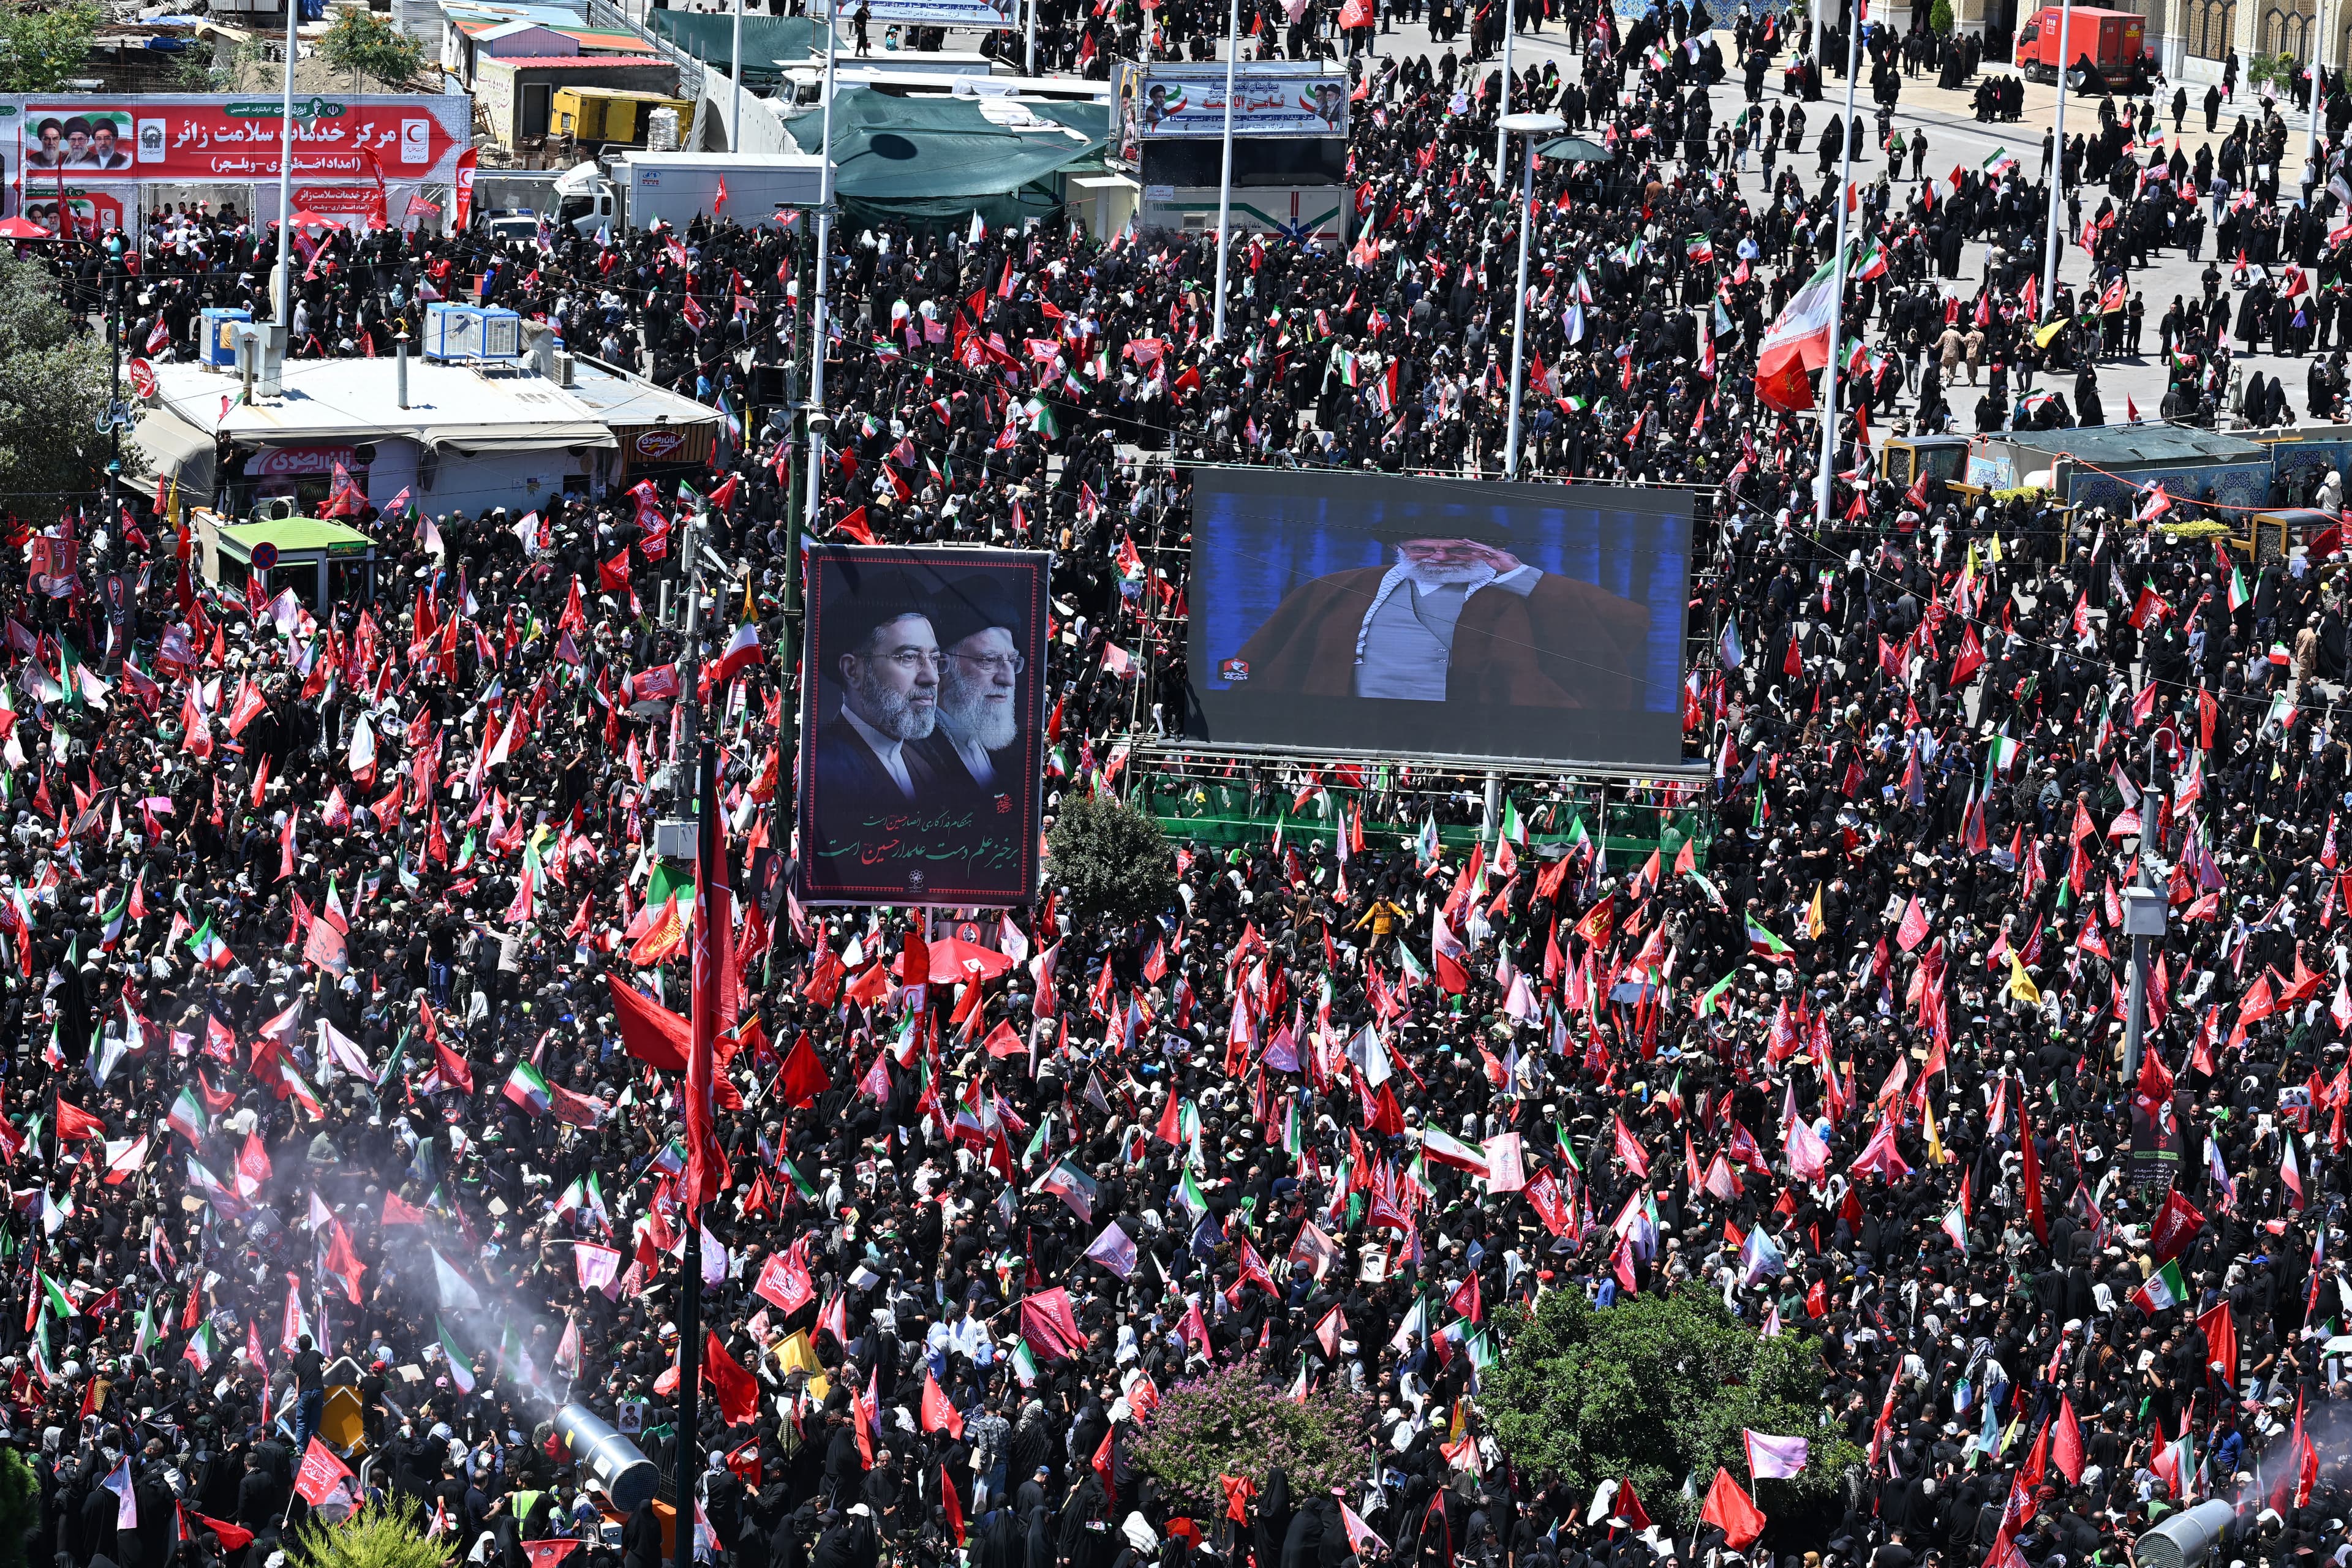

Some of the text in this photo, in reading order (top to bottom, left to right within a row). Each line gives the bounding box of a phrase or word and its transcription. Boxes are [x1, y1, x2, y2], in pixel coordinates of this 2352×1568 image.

[1246, 94, 1284, 112] ثامن
[172, 120, 209, 148] زائر
[214, 121, 274, 142] سلامت
[350, 122, 396, 148] مرکز
[299, 189, 379, 202] مرکز خدمات سلامت زائر
[95, 398, 125, 434] علی
[641, 435, 665, 445] رضوی
[271, 452, 326, 470] رضوی
[862, 816, 888, 826] است
[886, 815, 908, 831] حسین
[902, 810, 921, 827] انصار
[817, 837, 859, 858] است
[861, 838, 900, 865] حسین
[891, 842, 926, 858] علمدار
[925, 843, 968, 860] دست
[984, 837, 1019, 869] برخیز
